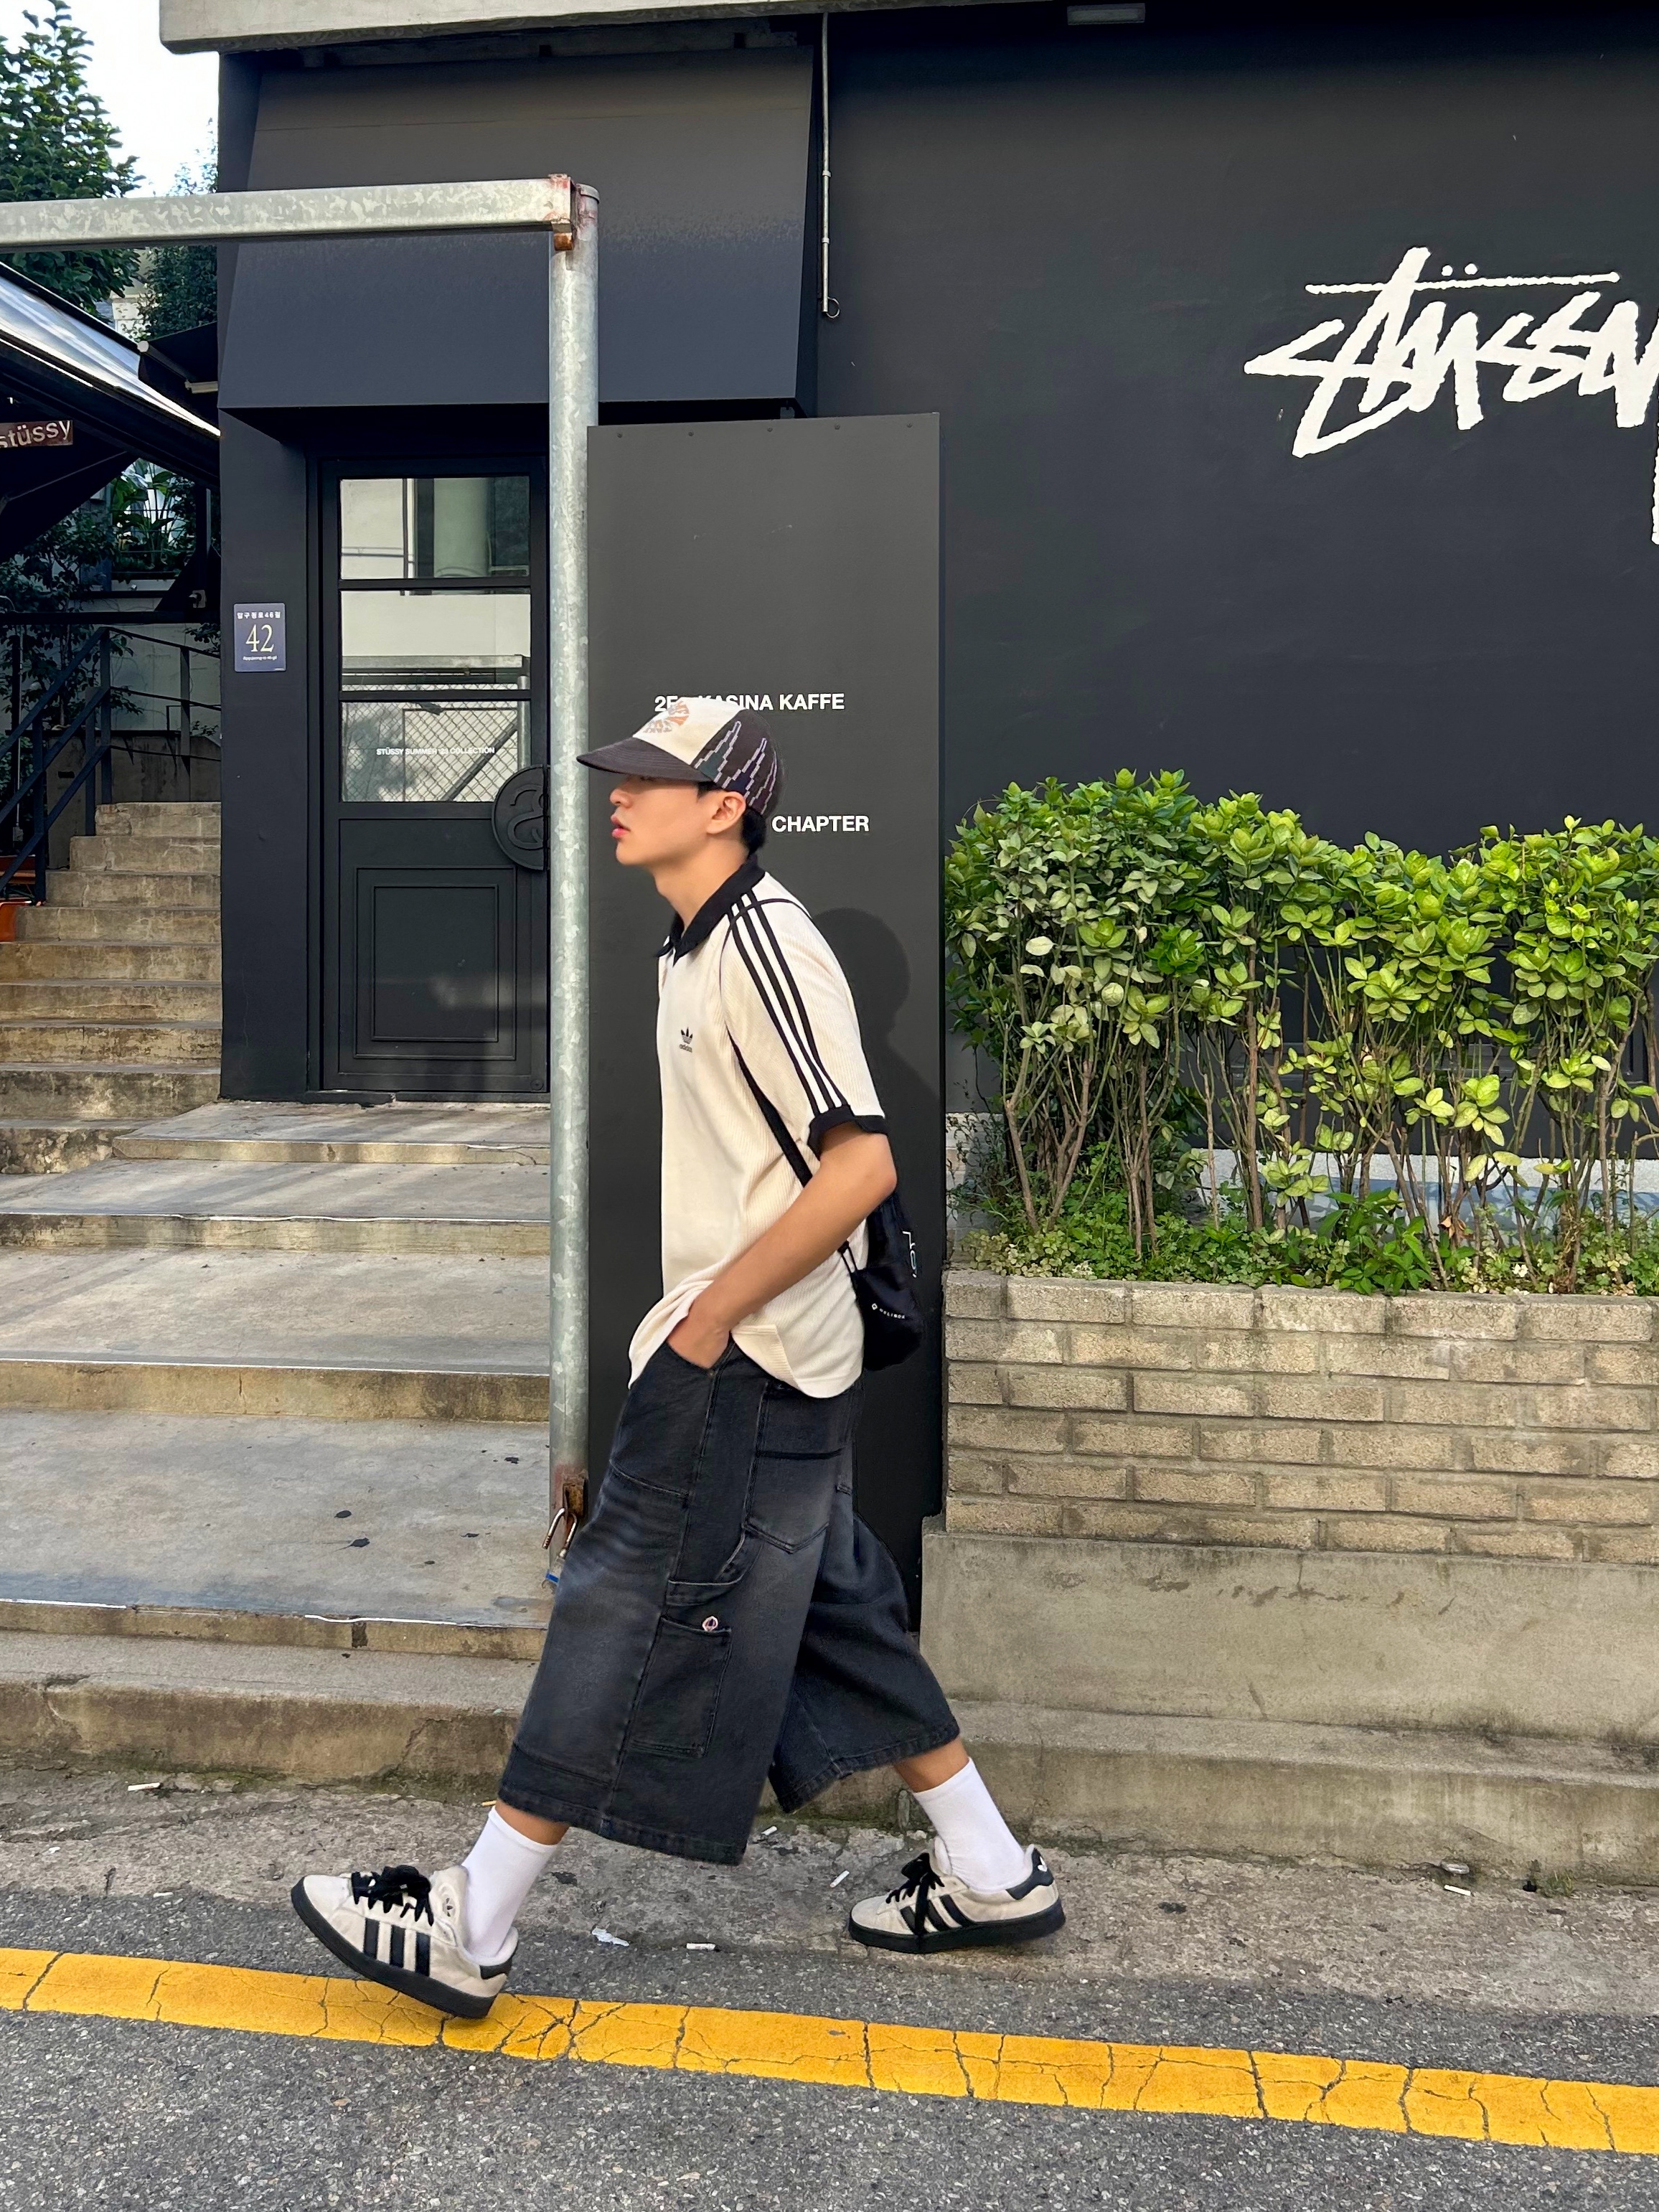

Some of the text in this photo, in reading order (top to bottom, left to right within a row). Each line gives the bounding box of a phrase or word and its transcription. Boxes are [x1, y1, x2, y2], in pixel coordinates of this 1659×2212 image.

[245, 623, 275, 652] 42
[779, 693, 845, 710] KAFFE
[771, 815, 870, 832] CHAPTER
